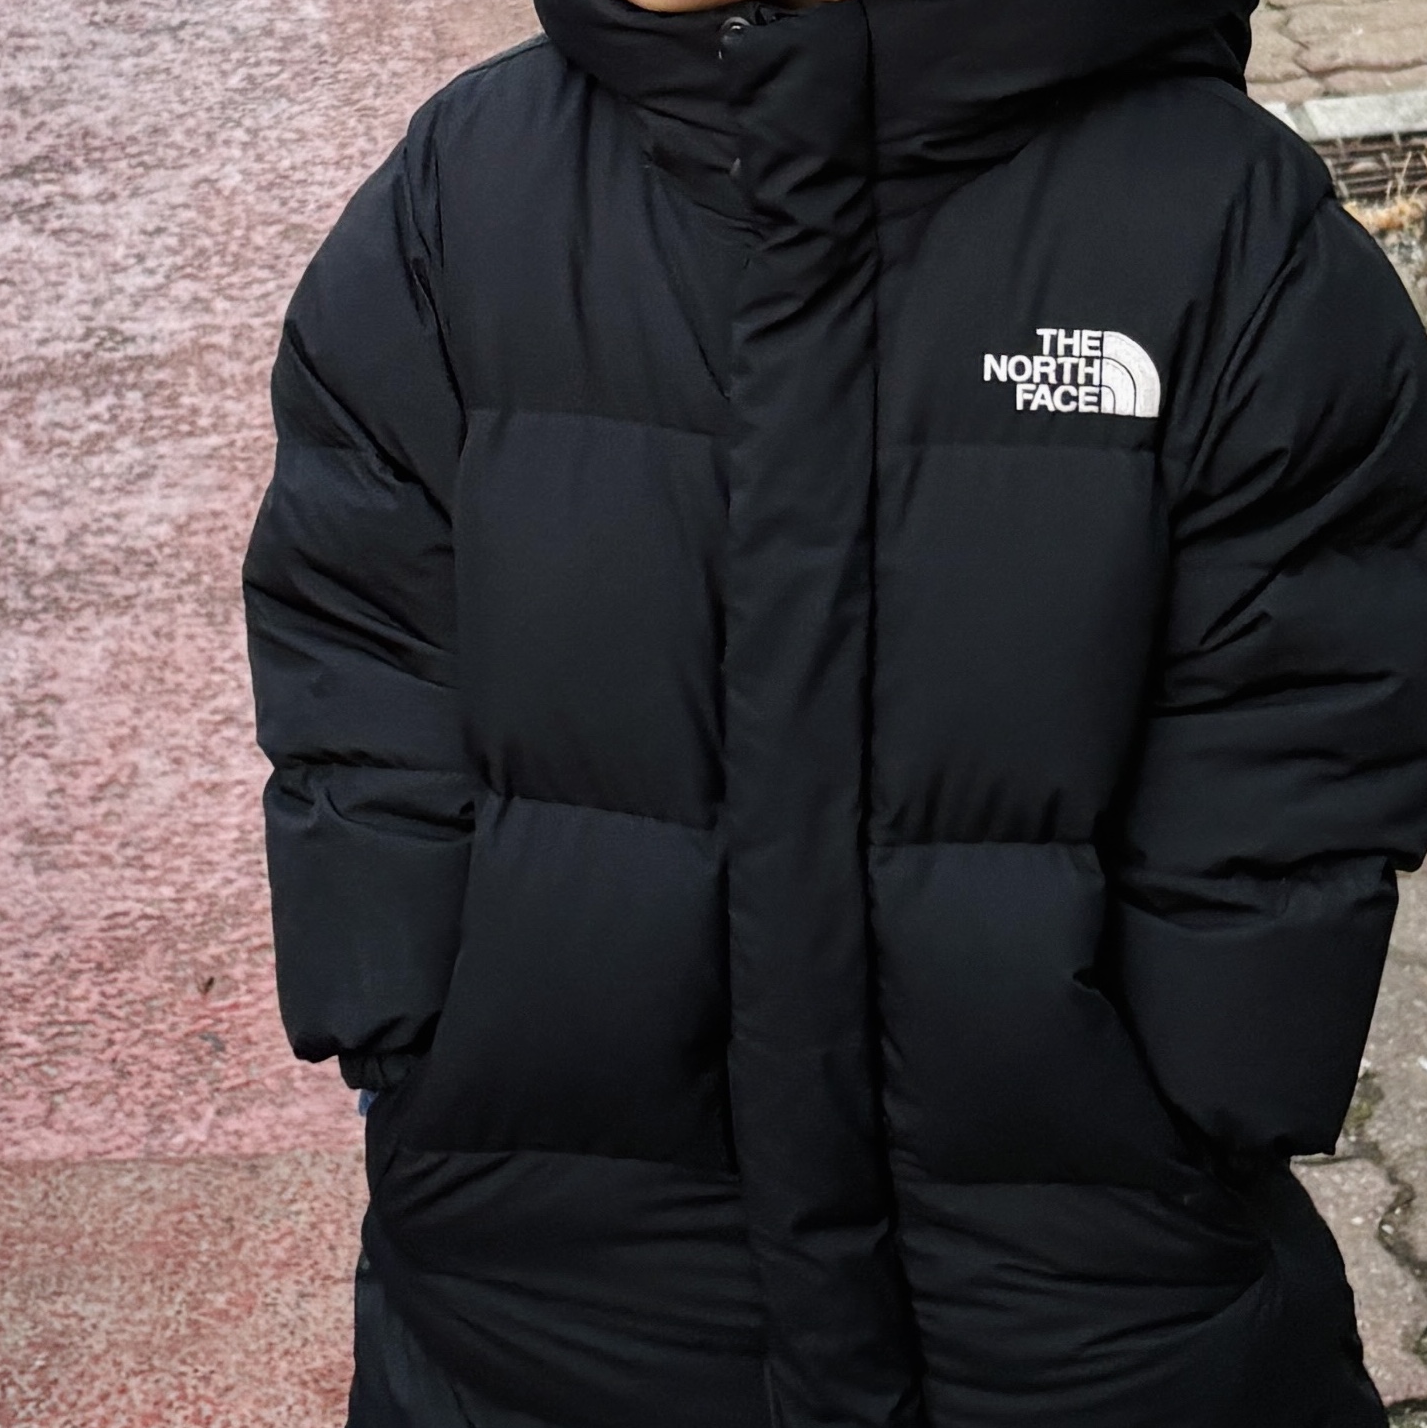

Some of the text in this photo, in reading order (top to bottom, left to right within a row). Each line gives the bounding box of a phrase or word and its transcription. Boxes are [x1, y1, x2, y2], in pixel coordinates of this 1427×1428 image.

[1036, 328, 1103, 357] THE
[983, 353, 1102, 386] NORTH
[1015, 383, 1100, 413] FACE
